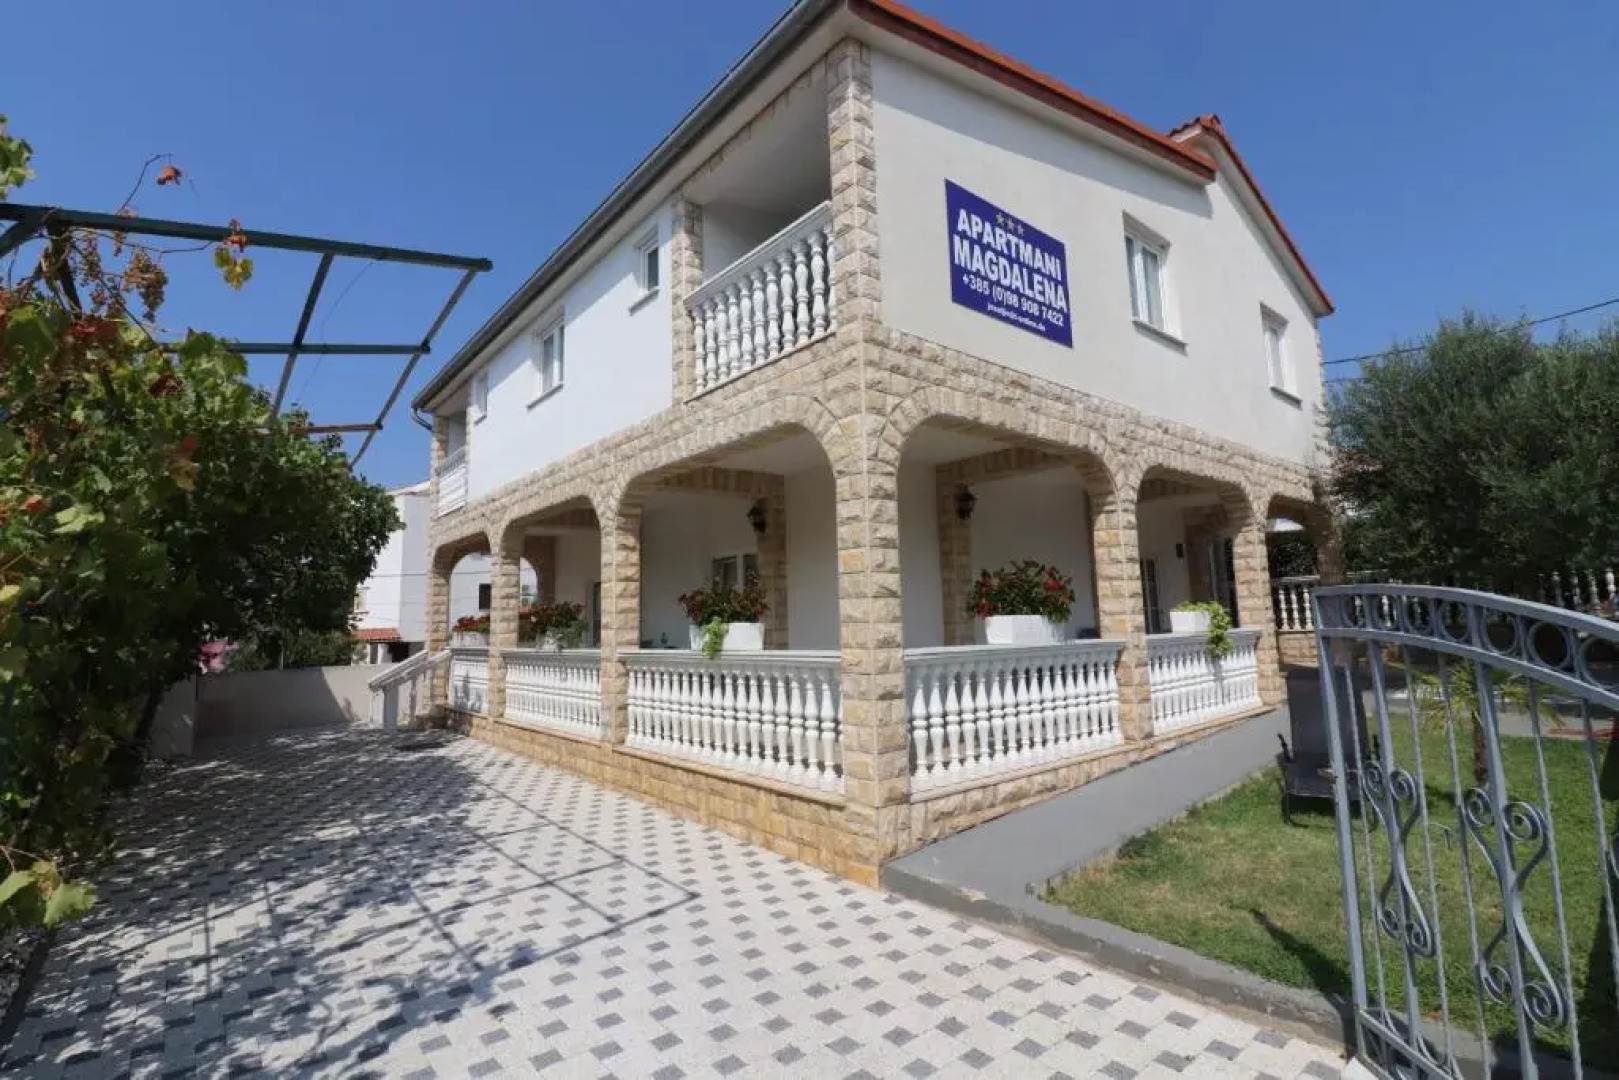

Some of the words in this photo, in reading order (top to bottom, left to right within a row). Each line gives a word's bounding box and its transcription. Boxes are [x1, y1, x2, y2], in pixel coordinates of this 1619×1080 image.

[954, 234, 1067, 313] MAGDALENA
[957, 209, 1062, 281] APARTMANI
[962, 274, 990, 295] +385
